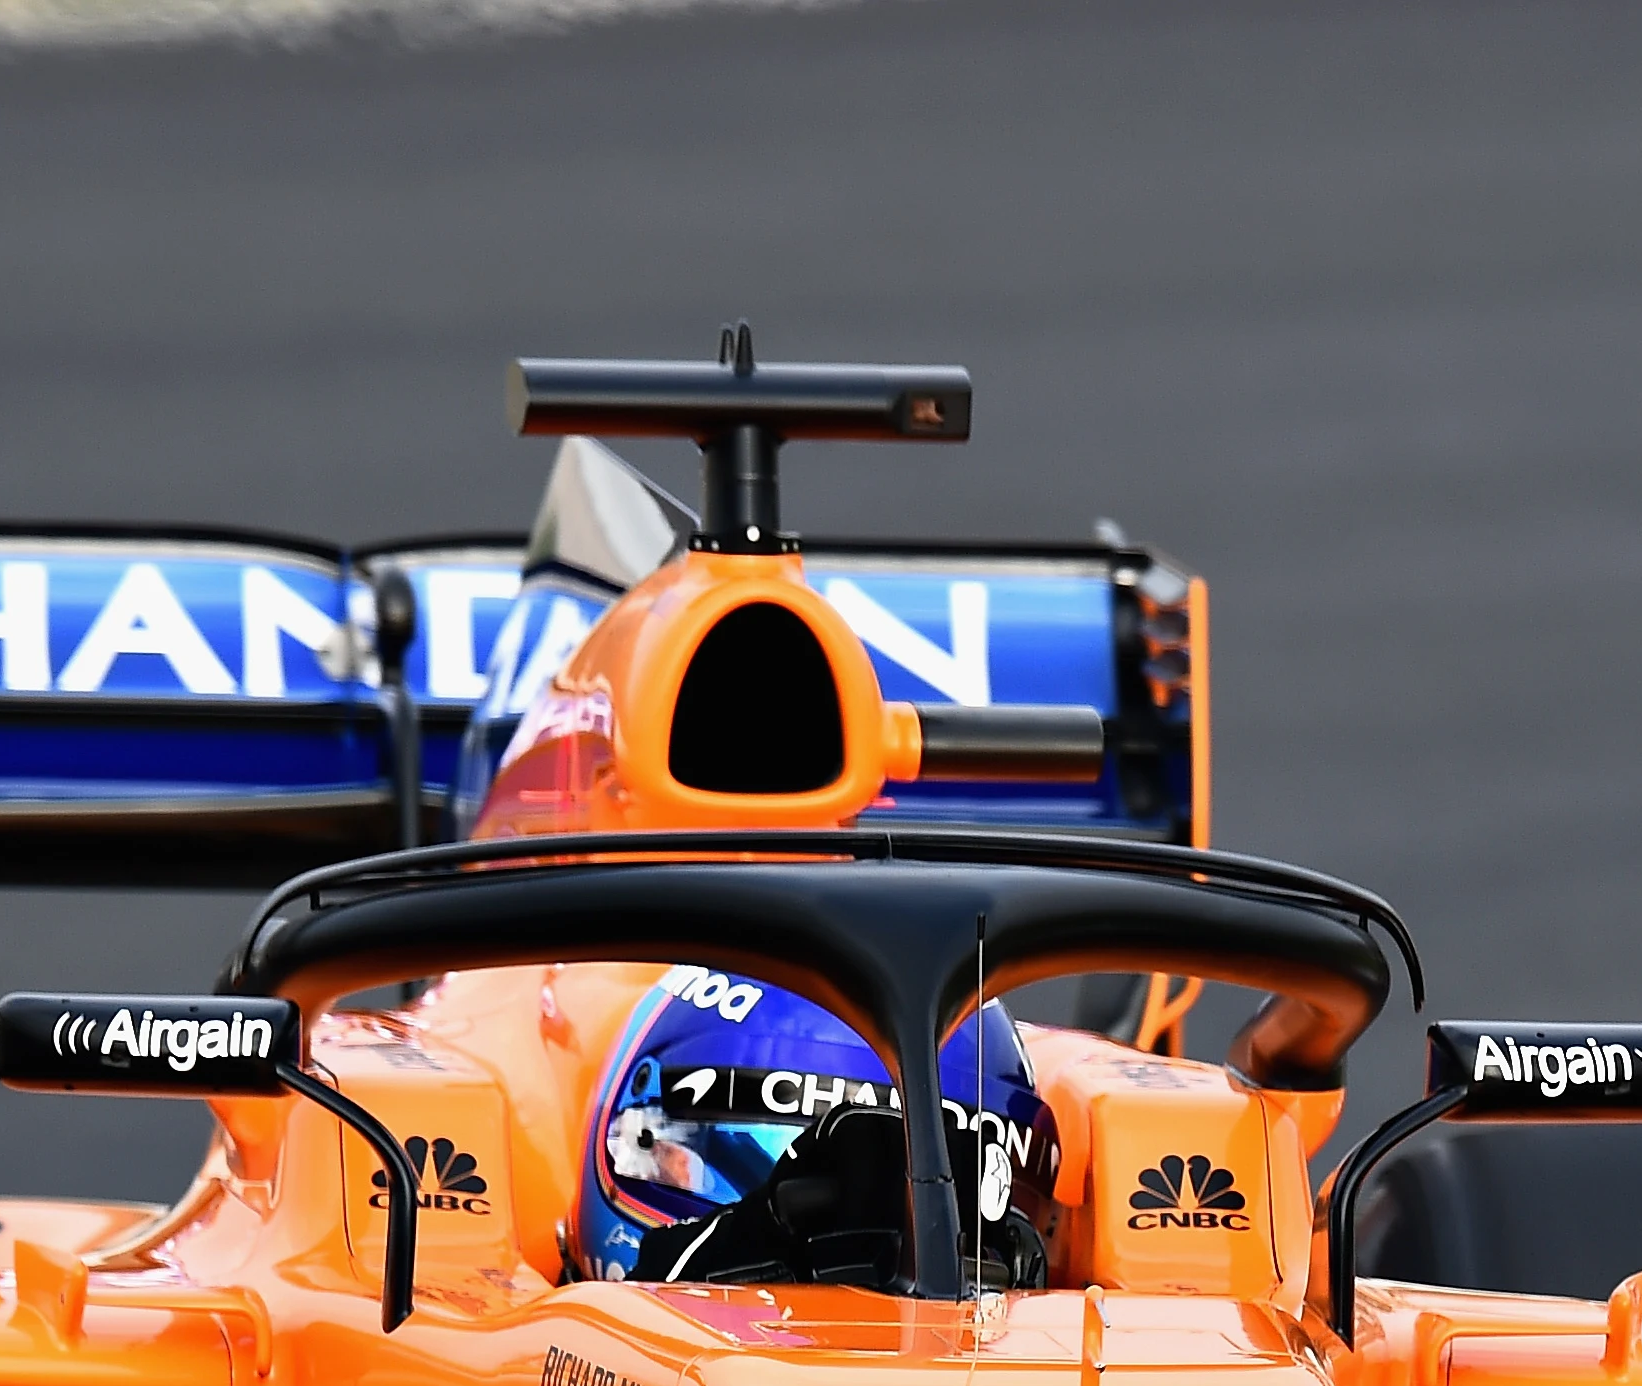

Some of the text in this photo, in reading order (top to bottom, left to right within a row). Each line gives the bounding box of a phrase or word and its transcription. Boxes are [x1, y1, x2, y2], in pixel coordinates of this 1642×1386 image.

[100, 1009, 273, 1072] Airgain
[1473, 1035, 1632, 1097] Airgain
[1127, 1211, 1251, 1232] CNBC
